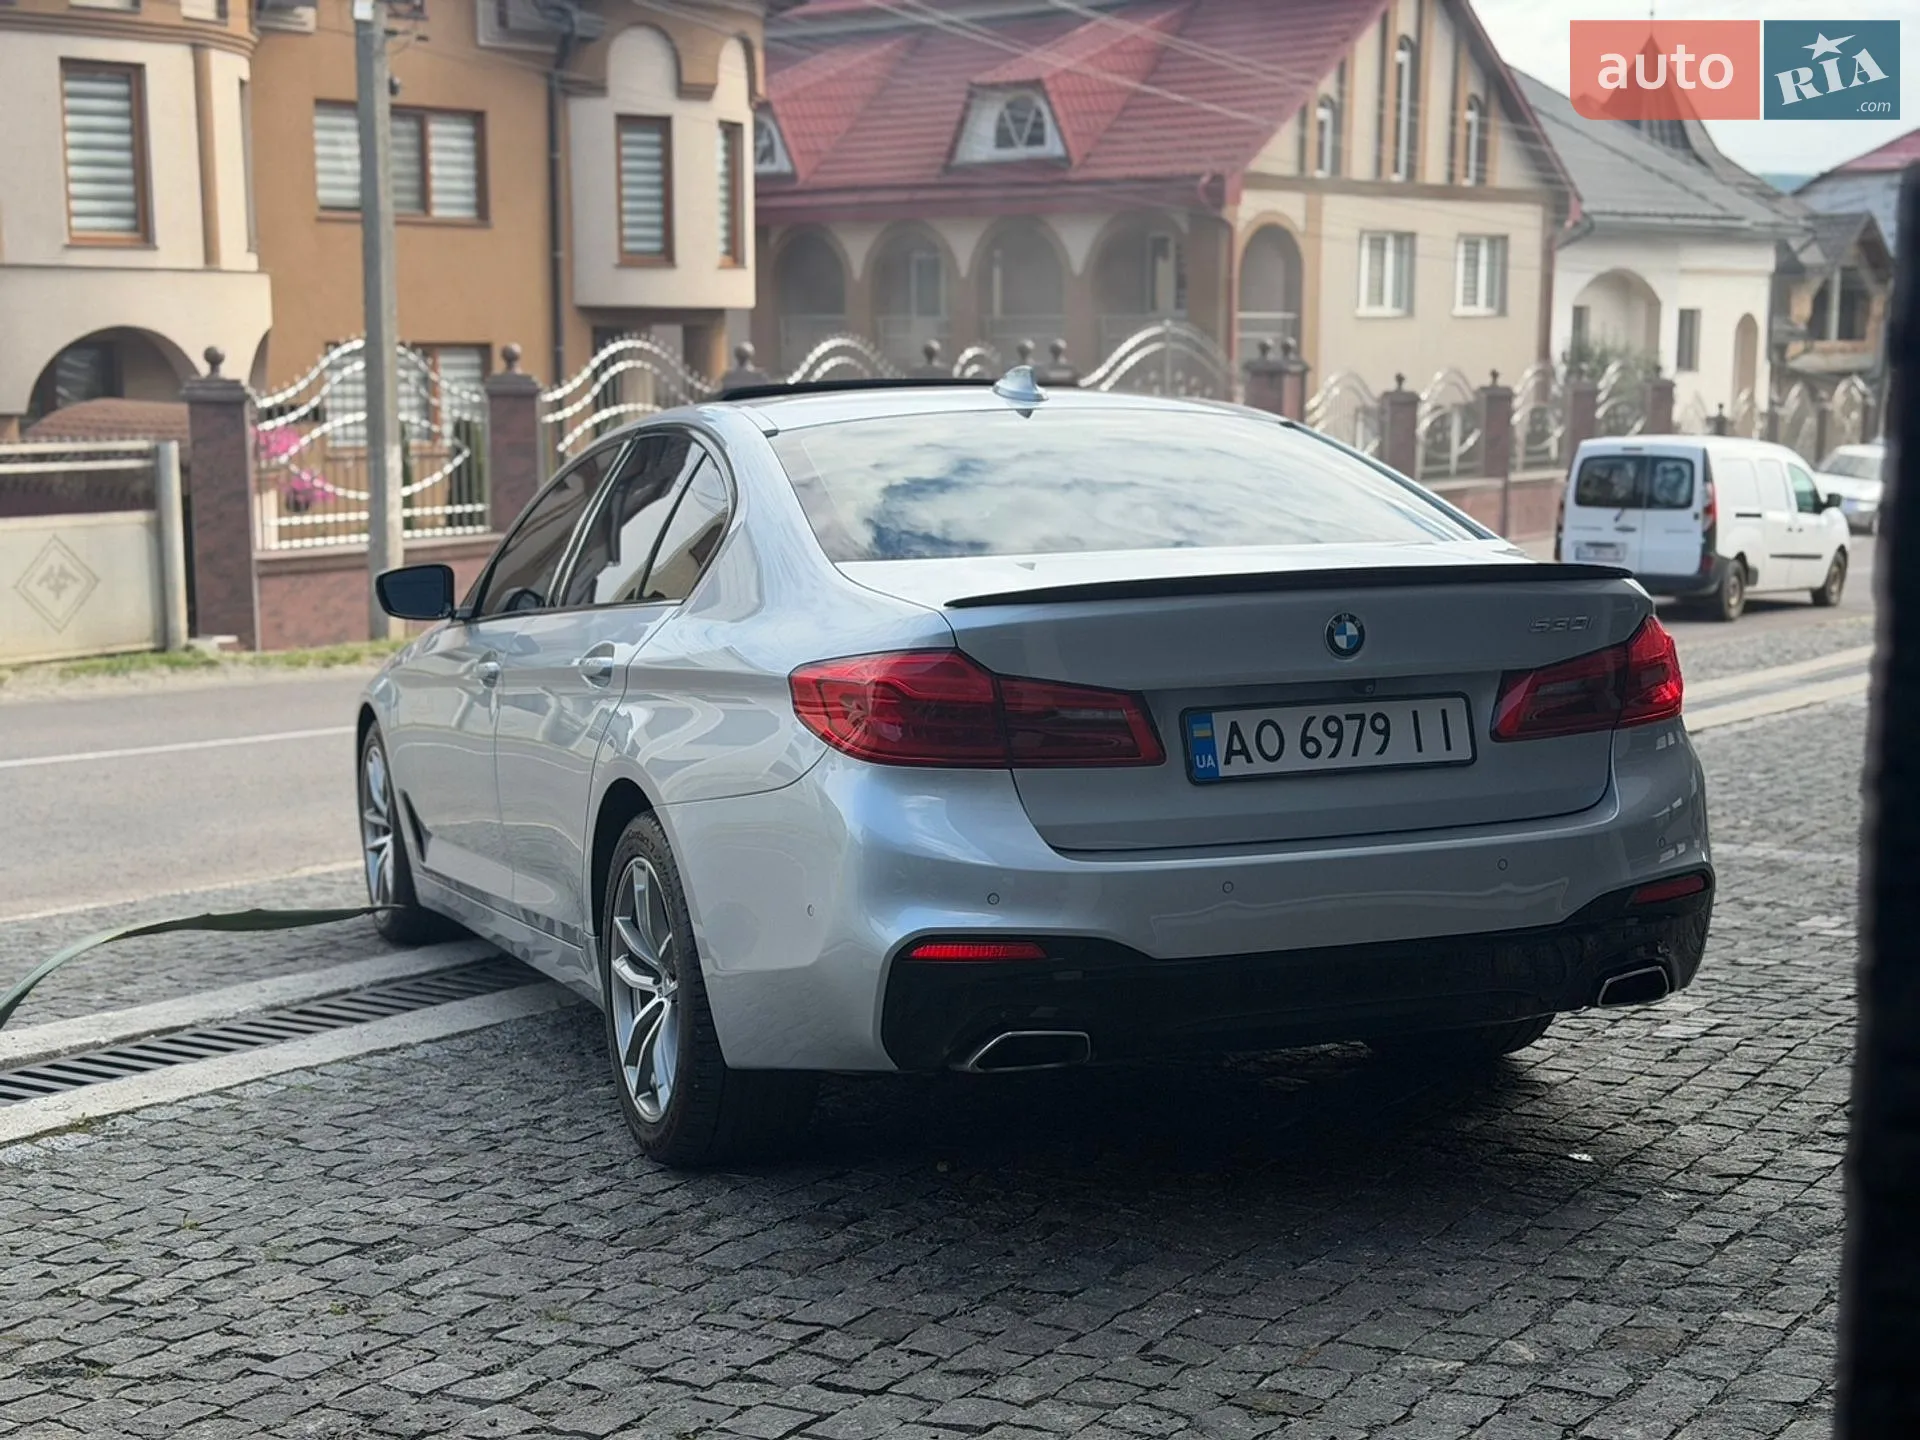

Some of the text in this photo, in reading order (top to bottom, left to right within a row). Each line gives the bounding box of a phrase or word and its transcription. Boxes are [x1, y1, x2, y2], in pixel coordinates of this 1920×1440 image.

[1223, 708, 1451, 766] AO 6979 II
[1196, 754, 1216, 768] UA
